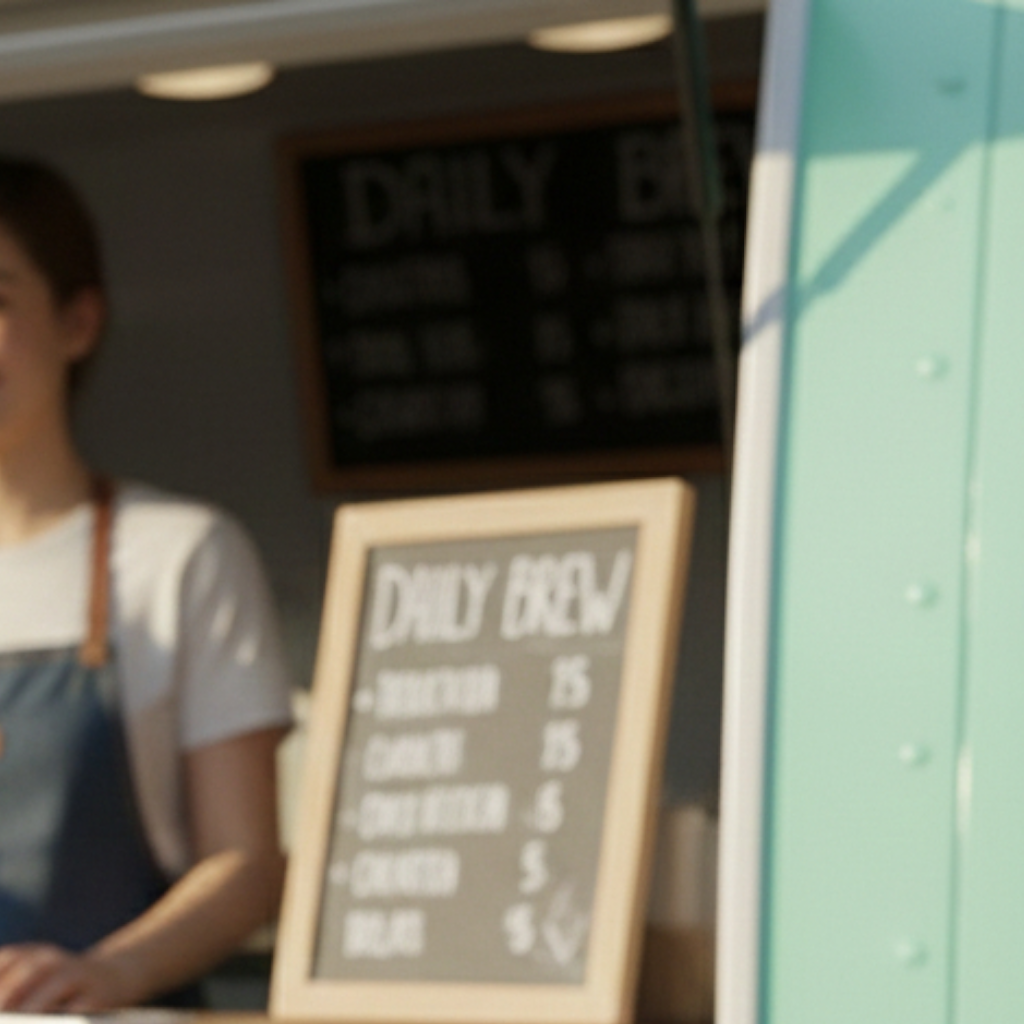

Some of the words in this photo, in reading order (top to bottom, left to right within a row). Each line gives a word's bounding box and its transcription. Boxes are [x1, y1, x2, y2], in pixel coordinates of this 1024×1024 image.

[342, 143, 555, 248] DAILY
[371, 563, 497, 650] DAILY
[501, 550, 631, 640] BREW
